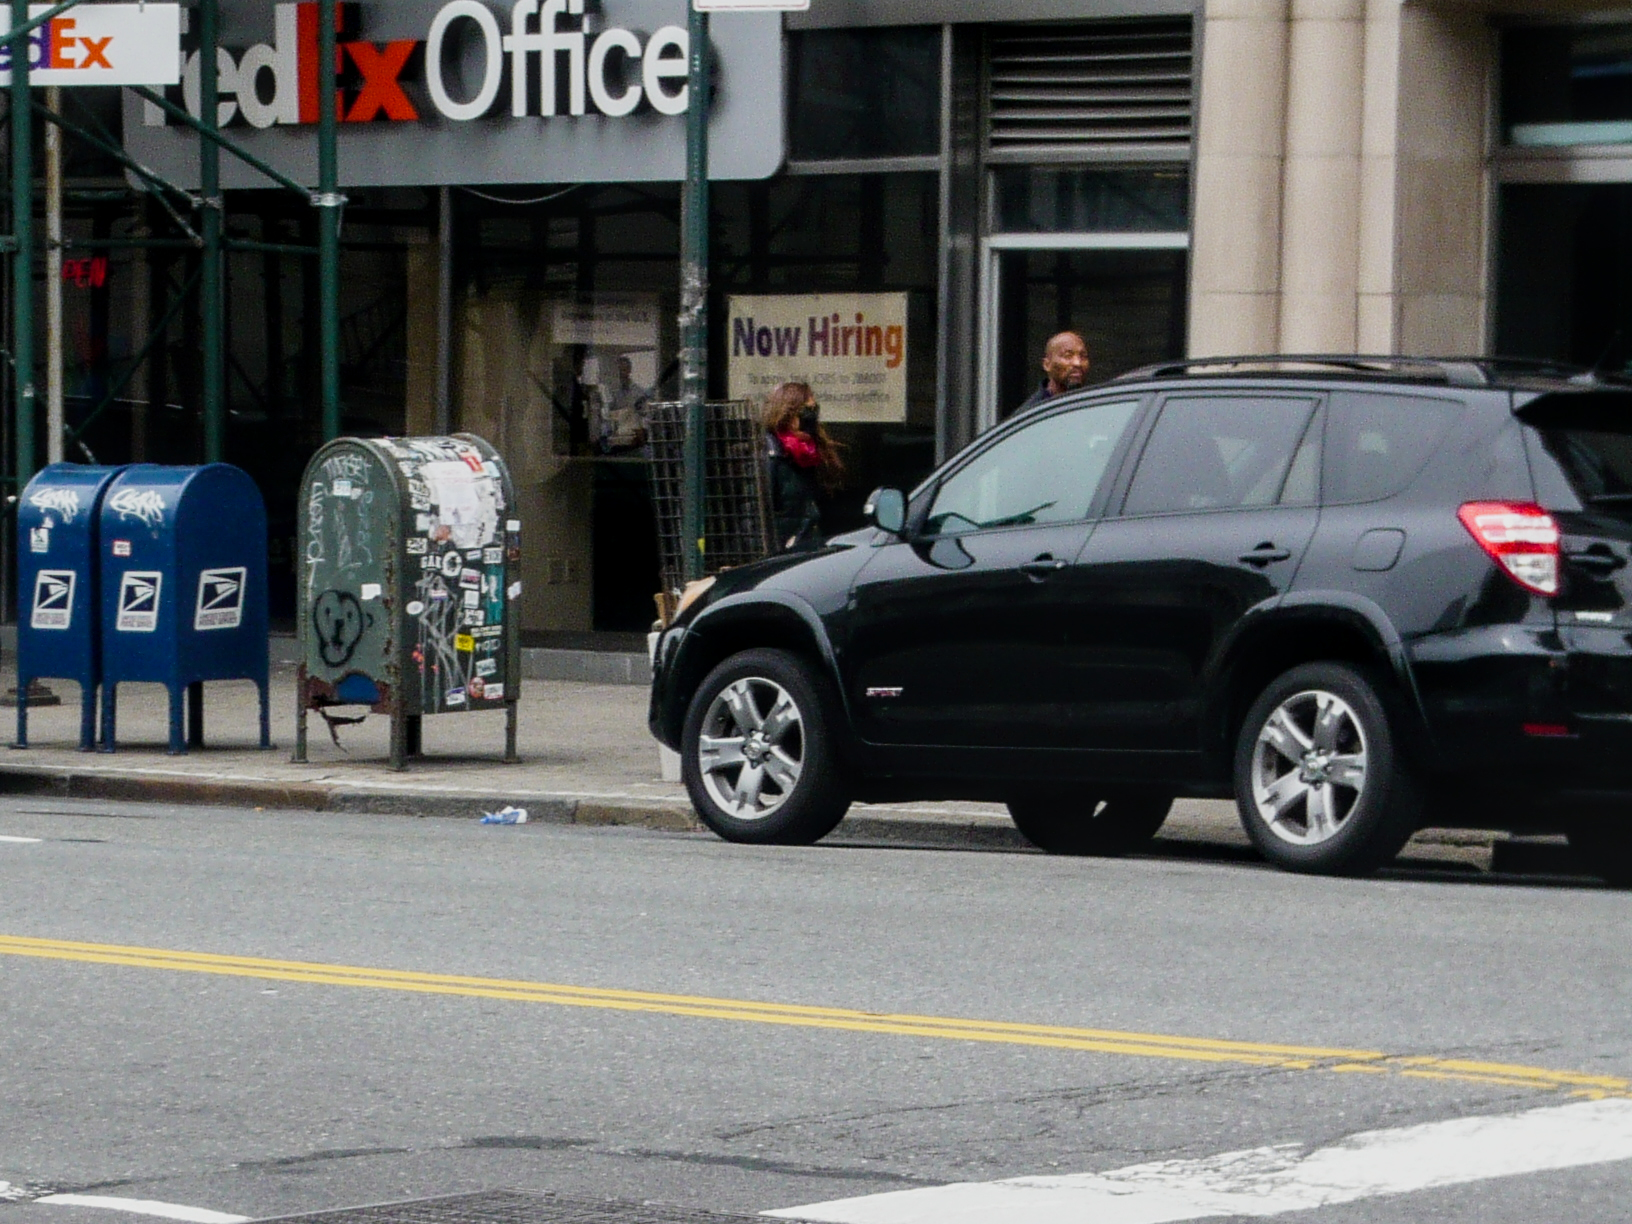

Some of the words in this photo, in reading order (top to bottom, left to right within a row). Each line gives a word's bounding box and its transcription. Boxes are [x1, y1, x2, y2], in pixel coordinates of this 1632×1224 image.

[143, 2, 419, 128] edEx
[425, 0, 688, 121] Office
[733, 316, 801, 358] Now
[808, 312, 904, 369] Hiring
